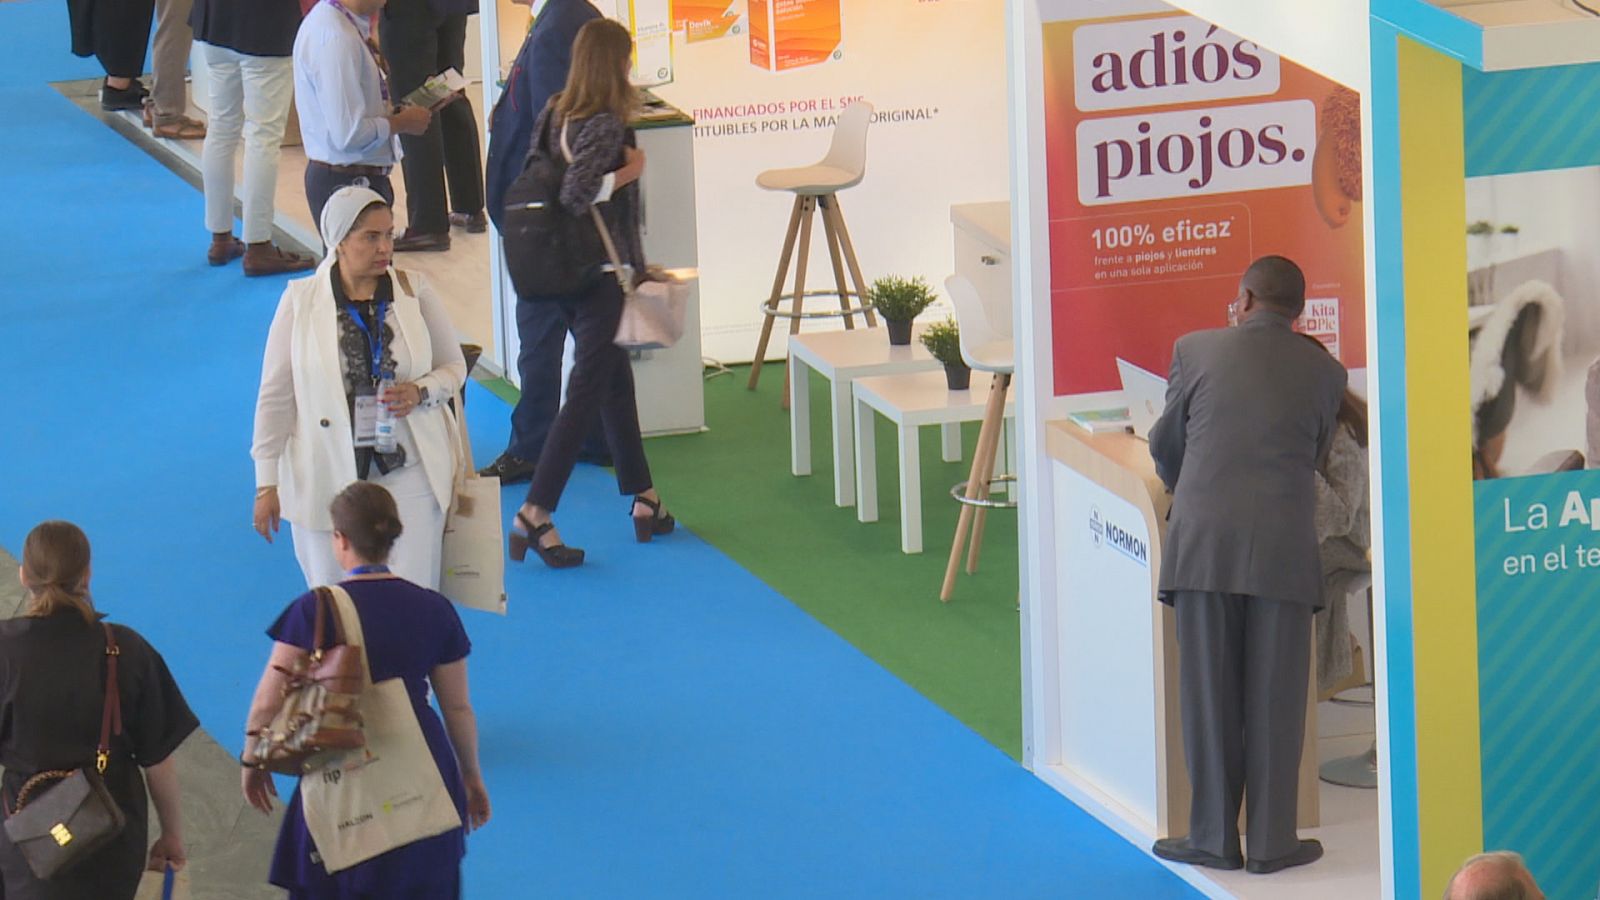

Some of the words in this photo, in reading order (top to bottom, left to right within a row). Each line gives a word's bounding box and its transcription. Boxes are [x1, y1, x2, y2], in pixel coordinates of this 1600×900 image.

[1091, 24, 1262, 93] adiós
[693, 102, 785, 121] FINANCIADOS
[790, 100, 816, 113] POR
[821, 98, 836, 111] EL
[761, 119, 788, 133] POR
[793, 117, 810, 130] LA
[1094, 116, 1305, 198] piojos.
[1092, 224, 1155, 250] 100%
[1094, 255, 1124, 265] frente
[1127, 255, 1133, 263] a
[1135, 250, 1165, 264] piojos
[1167, 251, 1173, 260] y
[1175, 246, 1217, 258] liendres
[1094, 270, 1107, 280] en
[1110, 267, 1128, 278] una
[1131, 264, 1151, 276] sola
[1154, 261, 1203, 275] aplicación
[1504, 497, 1548, 533] La
[1105, 520, 1147, 562] NORMON
[1503, 553, 1536, 576] en
[1543, 543, 1568, 571] el
